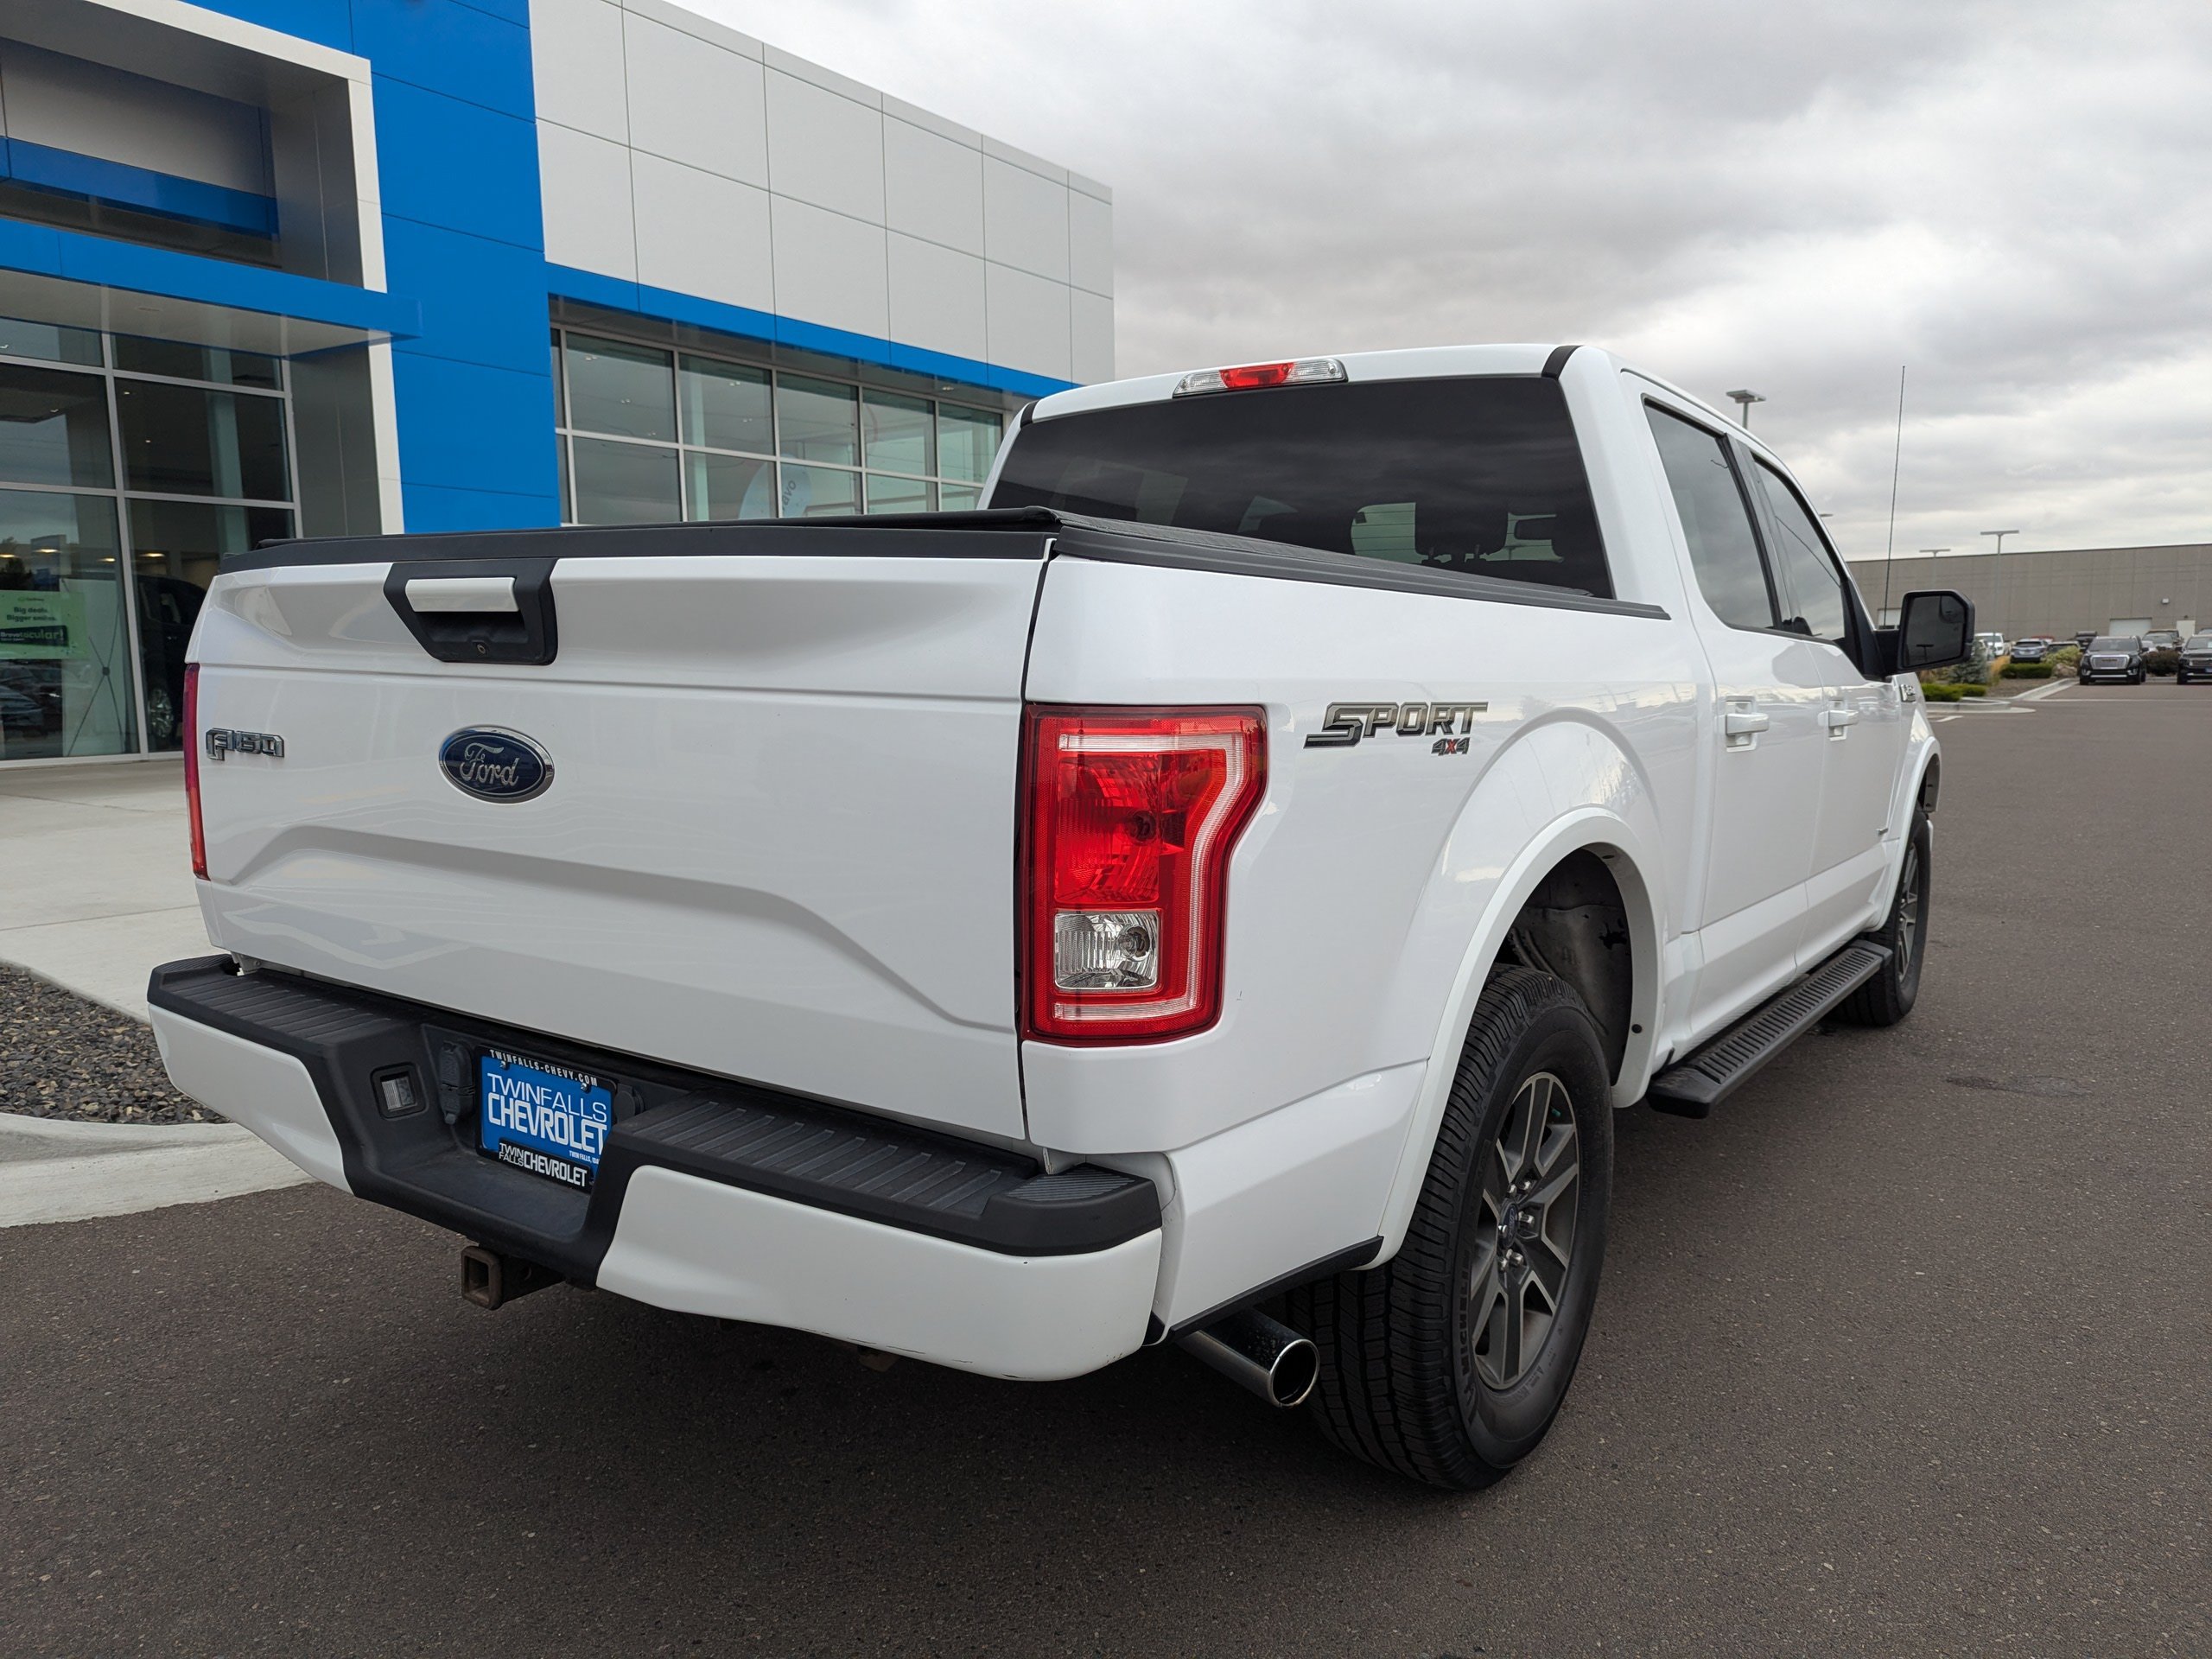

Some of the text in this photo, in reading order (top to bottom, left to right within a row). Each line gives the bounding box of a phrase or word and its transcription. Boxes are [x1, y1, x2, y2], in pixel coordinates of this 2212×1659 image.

[1303, 702, 1489, 749] SPORT
[460, 742, 520, 786] Ford
[490, 1049, 598, 1087] TWINFALLS-CHEVY.COM
[488, 1092, 607, 1154] CHEVROLET
[499, 1142, 524, 1158] TWIN
[499, 1152, 524, 1166] FALLS
[524, 1151, 588, 1187] CHEVROLET
